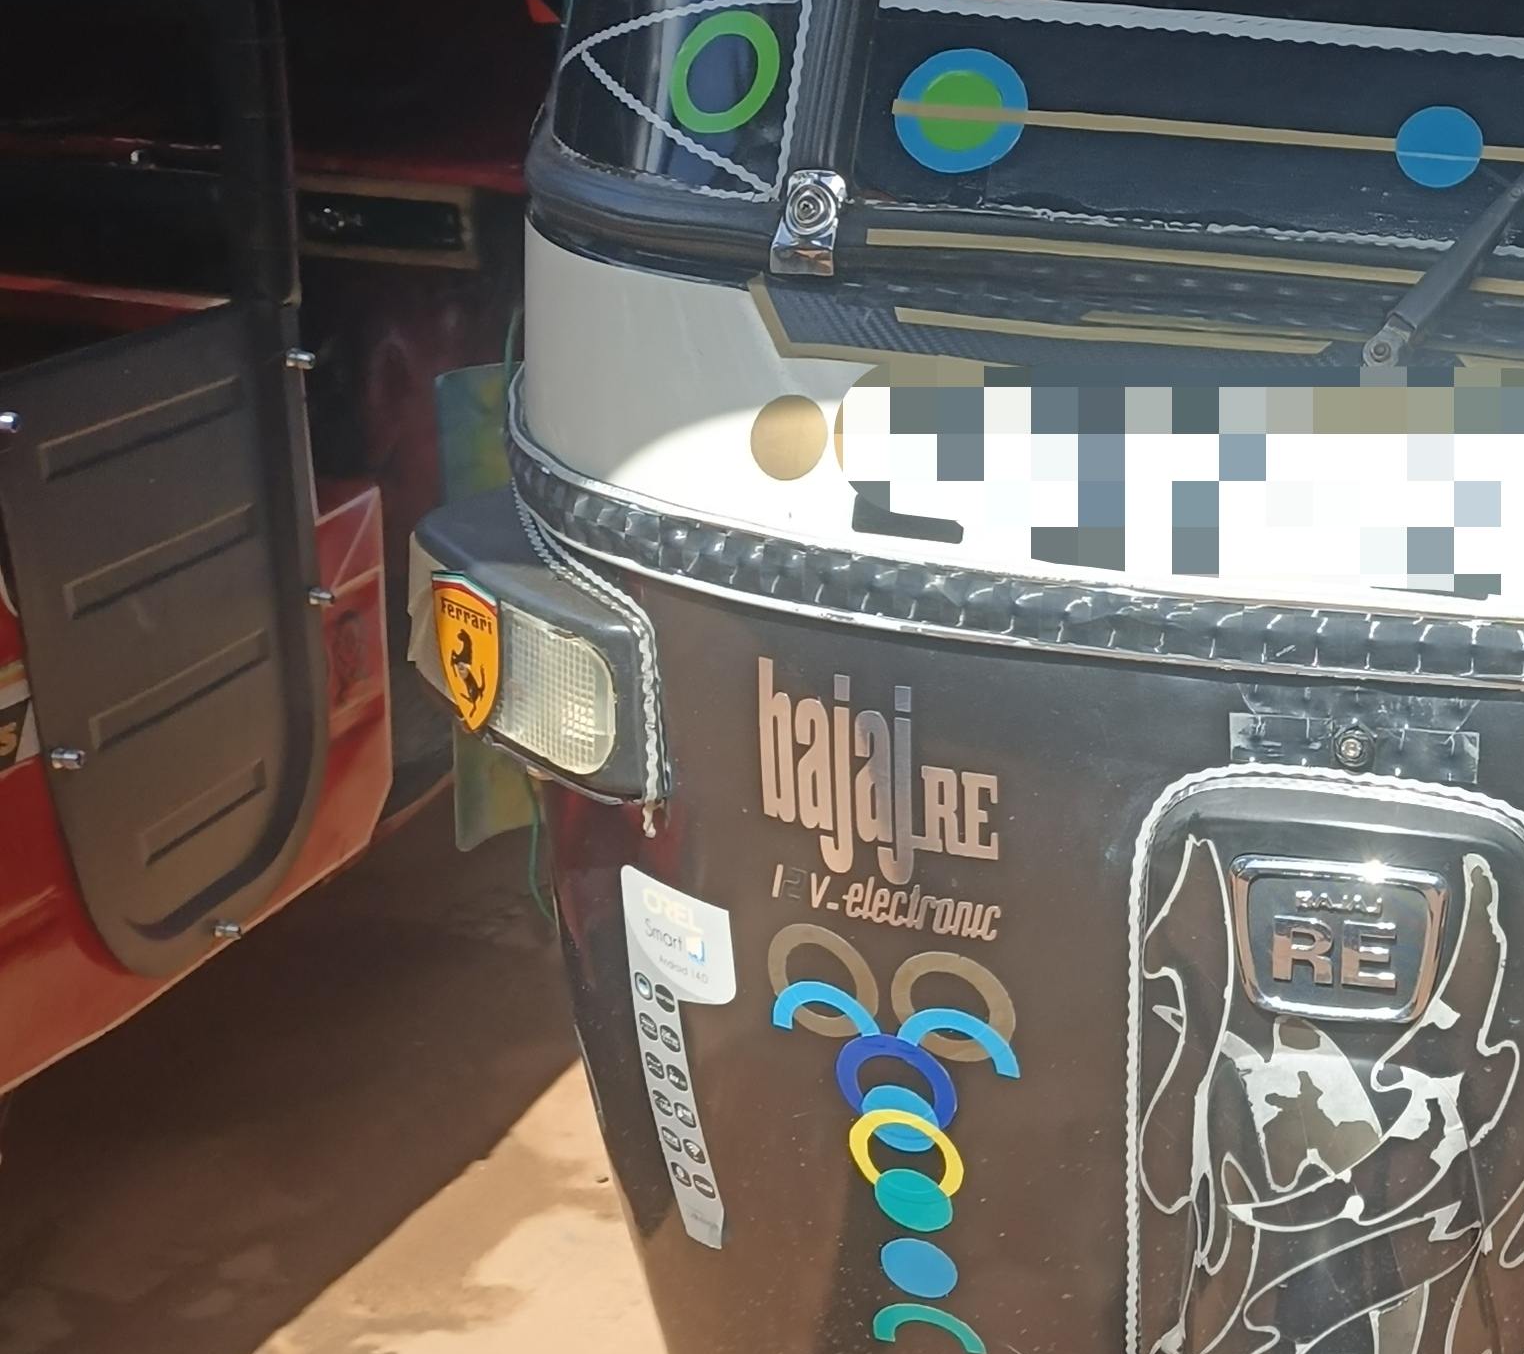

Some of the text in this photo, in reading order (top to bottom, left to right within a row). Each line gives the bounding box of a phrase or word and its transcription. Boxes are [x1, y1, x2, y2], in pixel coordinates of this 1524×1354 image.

[441, 596, 493, 635] Ferrari
[758, 656, 999, 885] bajaj RE
[1295, 890, 1384, 914] BAJAJ
[644, 917, 683, 952] Smart
[1271, 914, 1397, 989] RE
